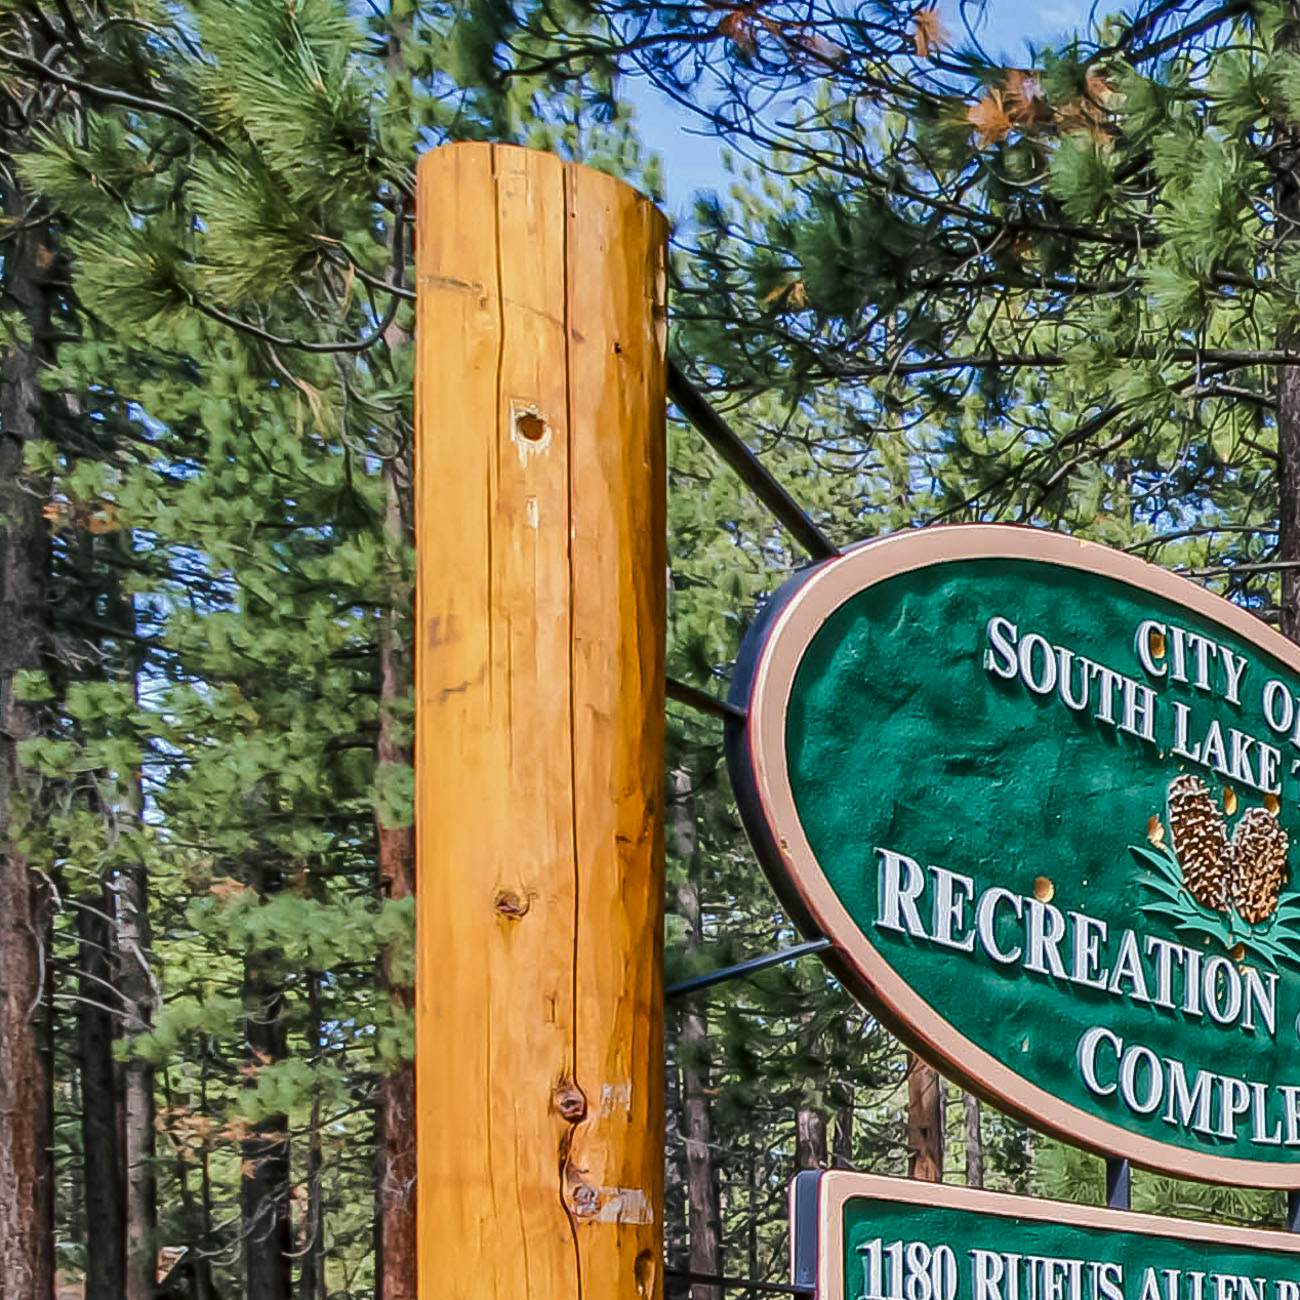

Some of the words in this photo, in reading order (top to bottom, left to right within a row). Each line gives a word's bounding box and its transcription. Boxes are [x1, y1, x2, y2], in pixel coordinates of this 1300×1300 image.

[985, 616, 1157, 742] SOUTH
[1173, 701, 1282, 796] LAKE
[1135, 619, 1248, 704] CITY
[874, 848, 1279, 1034] RECREATION
